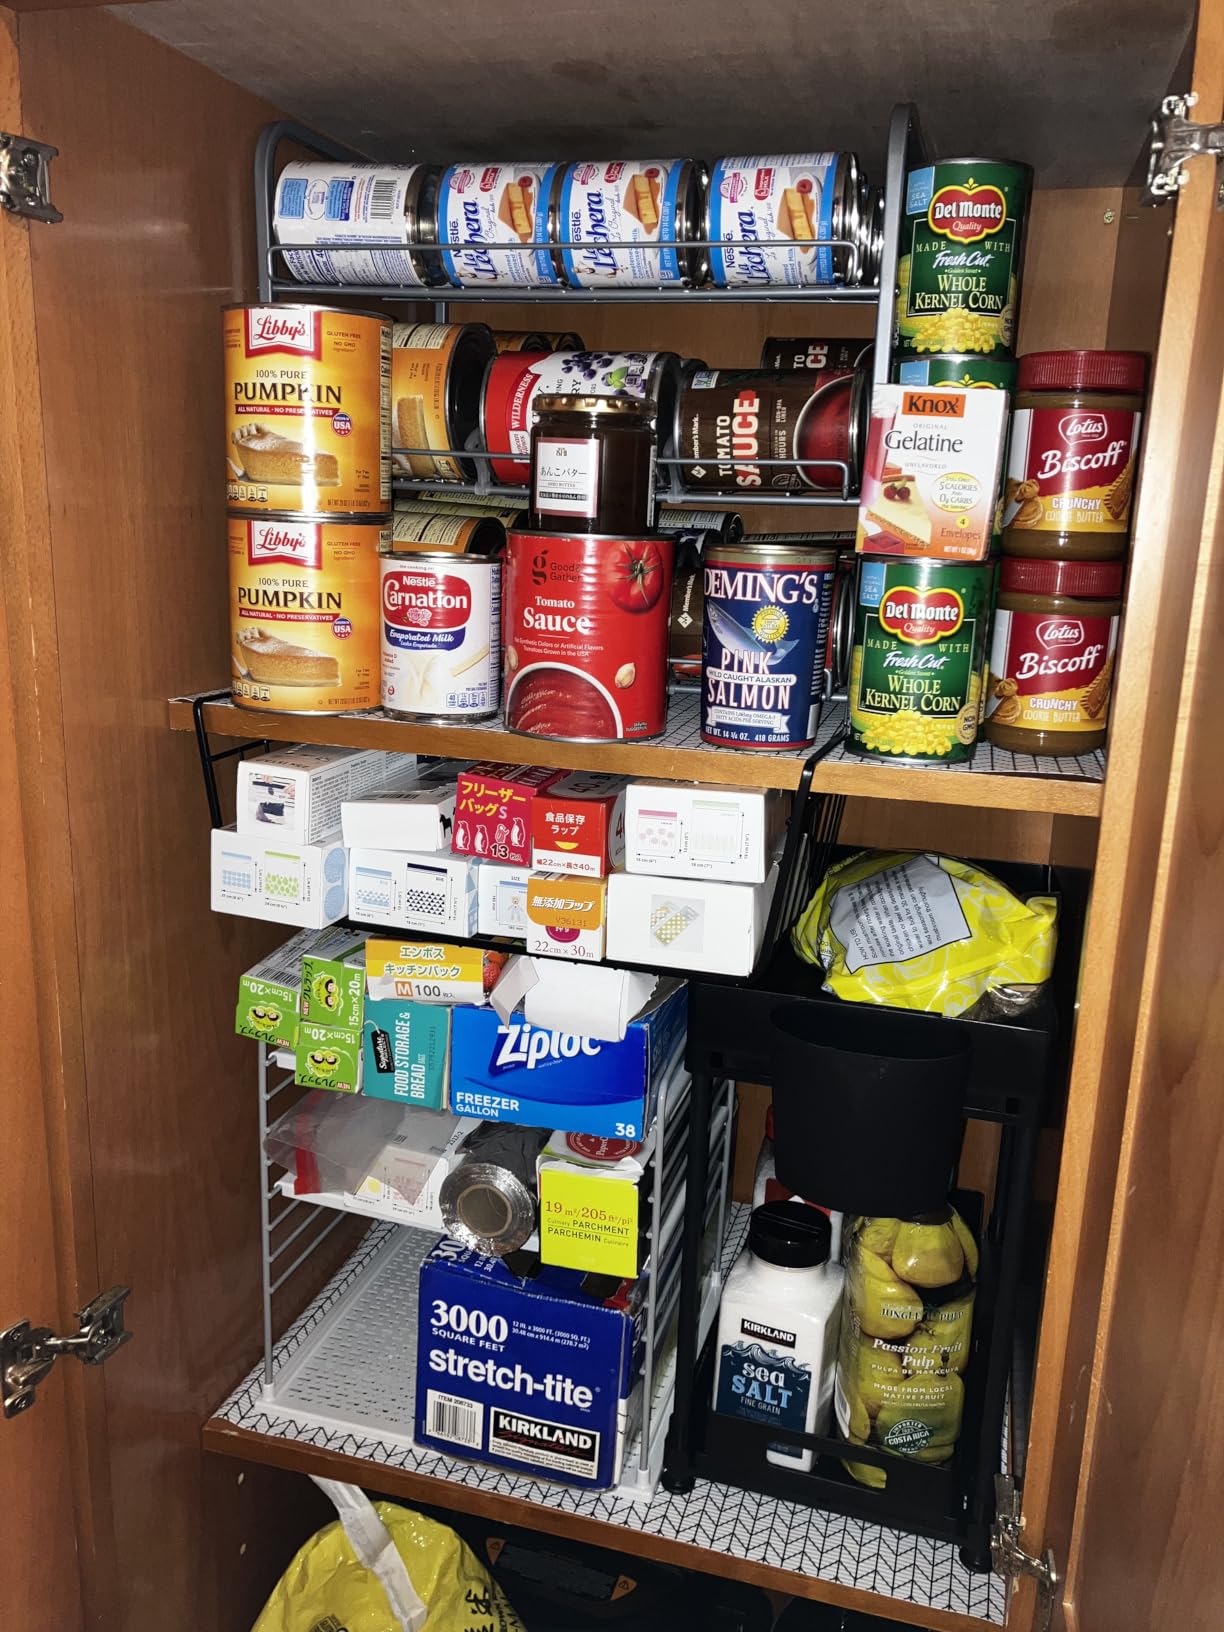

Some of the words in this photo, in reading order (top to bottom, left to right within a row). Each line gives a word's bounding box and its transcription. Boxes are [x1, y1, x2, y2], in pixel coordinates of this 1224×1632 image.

[909, 199, 927, 208] SALT
[911, 191, 926, 201] SEA
[934, 203, 957, 219] Del
[958, 201, 1002, 218] Monte
[952, 221, 982, 232] Quality
[916, 241, 947, 252] MADE
[984, 241, 1010, 252] WITH
[933, 250, 966, 269] Fresh
[965, 251, 992, 268] Cut
[937, 274, 987, 291] WHOLE
[915, 292, 966, 309] KERNEL
[968, 291, 1003, 310] CORN
[252, 315, 307, 342] Libby's
[326, 330, 349, 338] GLUTEN
[256, 369, 277, 379] 100%
[280, 370, 307, 379] PURE
[511, 373, 534, 430] WILDERNESS
[333, 421, 350, 430] USA
[1066, 419, 1103, 436] Lotus
[732, 398, 762, 487] SAUCE
[885, 431, 963, 453] Gelatine
[904, 462, 947, 470] UNFLAVORED
[1037, 441, 1123, 479] Biscoff
[540, 467, 587, 478] あんこバター
[945, 483, 978, 491] CALORIES
[1052, 498, 1101, 510] CRUNCHY
[255, 527, 306, 551] Libby's
[941, 528, 981, 542] Envelopes
[551, 562, 576, 572] Good
[258, 577, 280, 587] 100%
[282, 579, 309, 588] PURE
[402, 575, 436, 587] Nestlé
[550, 572, 581, 582] Gather
[704, 568, 818, 604] DEMING'S
[863, 586, 878, 594] SEA
[238, 587, 342, 610] PUMPKIN
[384, 579, 468, 611] Carnation
[535, 596, 575, 609] Tomato
[862, 593, 879, 601] SALT
[286, 614, 334, 622] PRESERVATIVES
[886, 602, 908, 619] Del
[910, 603, 959, 621] Monte
[523, 607, 592, 634] Sauce
[334, 624, 351, 634] USA
[389, 629, 431, 643] Evaporated
[432, 633, 454, 643] Milk
[903, 622, 936, 635] Quality
[1043, 623, 1080, 641] Lotus
[867, 638, 897, 650] MADE
[938, 643, 969, 653] WITH
[721, 648, 775, 675] PINK
[883, 651, 918, 669] Fresh
[917, 653, 947, 669] Cut
[1016, 646, 1101, 680] Biscoff
[722, 672, 755, 682] CAUGHT
[755, 676, 792, 684] ALASKAN
[888, 674, 941, 695] WHOLE
[708, 678, 790, 710] SALMON
[865, 688, 917, 710] KERNEL
[920, 694, 962, 711] CORN
[1030, 697, 1077, 710] CRUNCHY
[963, 715, 976, 723] NON
[1023, 710, 1050, 721] COOKIE
[1053, 710, 1080, 723] BUTTER
[962, 722, 975, 731] GMO
[722, 730, 729, 738] 14
[754, 734, 766, 742] 418
[767, 734, 790, 742] GRAMS
[460, 781, 526, 803] フリーザー
[544, 811, 586, 825] 食品保存
[550, 825, 579, 836] ラップ
[532, 896, 596, 912] 無添加ラップ
[400, 946, 444, 959] エンボス
[859, 946, 869, 960] HOW
[384, 963, 461, 977] キッチンバック
[303, 962, 313, 1000] クレラップ
[397, 982, 412, 996] M
[239, 1024, 275, 1042] クレラップ
[276, 1038, 290, 1047] NEW
[394, 1020, 410, 1068] STORAGE
[495, 1023, 601, 1070] Ziploc
[375, 1036, 389, 1069] Signature
[299, 1073, 336, 1088] クレラップ
[394, 1070, 409, 1096] FOOD
[410, 1064, 425, 1099] BREAD
[456, 1092, 519, 1112] FREEZER
[456, 1103, 499, 1118] GALLON
[614, 1122, 636, 1138] 38
[545, 1201, 563, 1214] 19
[547, 1227, 601, 1243] PARCHEMIN
[572, 1220, 630, 1236] PARCHMENT
[430, 1299, 509, 1342] 3000
[512, 1327, 526, 1336] 30.48
[539, 1334, 555, 1342] 914.4
[532, 1325, 546, 1333] 3000
[743, 1320, 795, 1343] KIRKLAND
[431, 1327, 476, 1347] SQUARE
[479, 1340, 505, 1353] FEET
[872, 1338, 929, 1355] Passion
[931, 1341, 963, 1354] Fruit
[871, 1364, 898, 1374] PULPA
[902, 1355, 935, 1369] Pulp
[429, 1348, 593, 1409] stretch-tite
[742, 1362, 786, 1387] sea
[731, 1375, 793, 1410] SALT
[873, 1383, 898, 1392] MADE
[438, 1394, 453, 1402] ITEM
[883, 1392, 916, 1401] NATIVE
[740, 1396, 757, 1409] FINE
[757, 1400, 781, 1415] GRAIN
[499, 1414, 593, 1450] KIRKLAND
[893, 1421, 922, 1434] IMPORTED
[888, 1434, 913, 1445] COSTA
[913, 1430, 930, 1440] RICA
